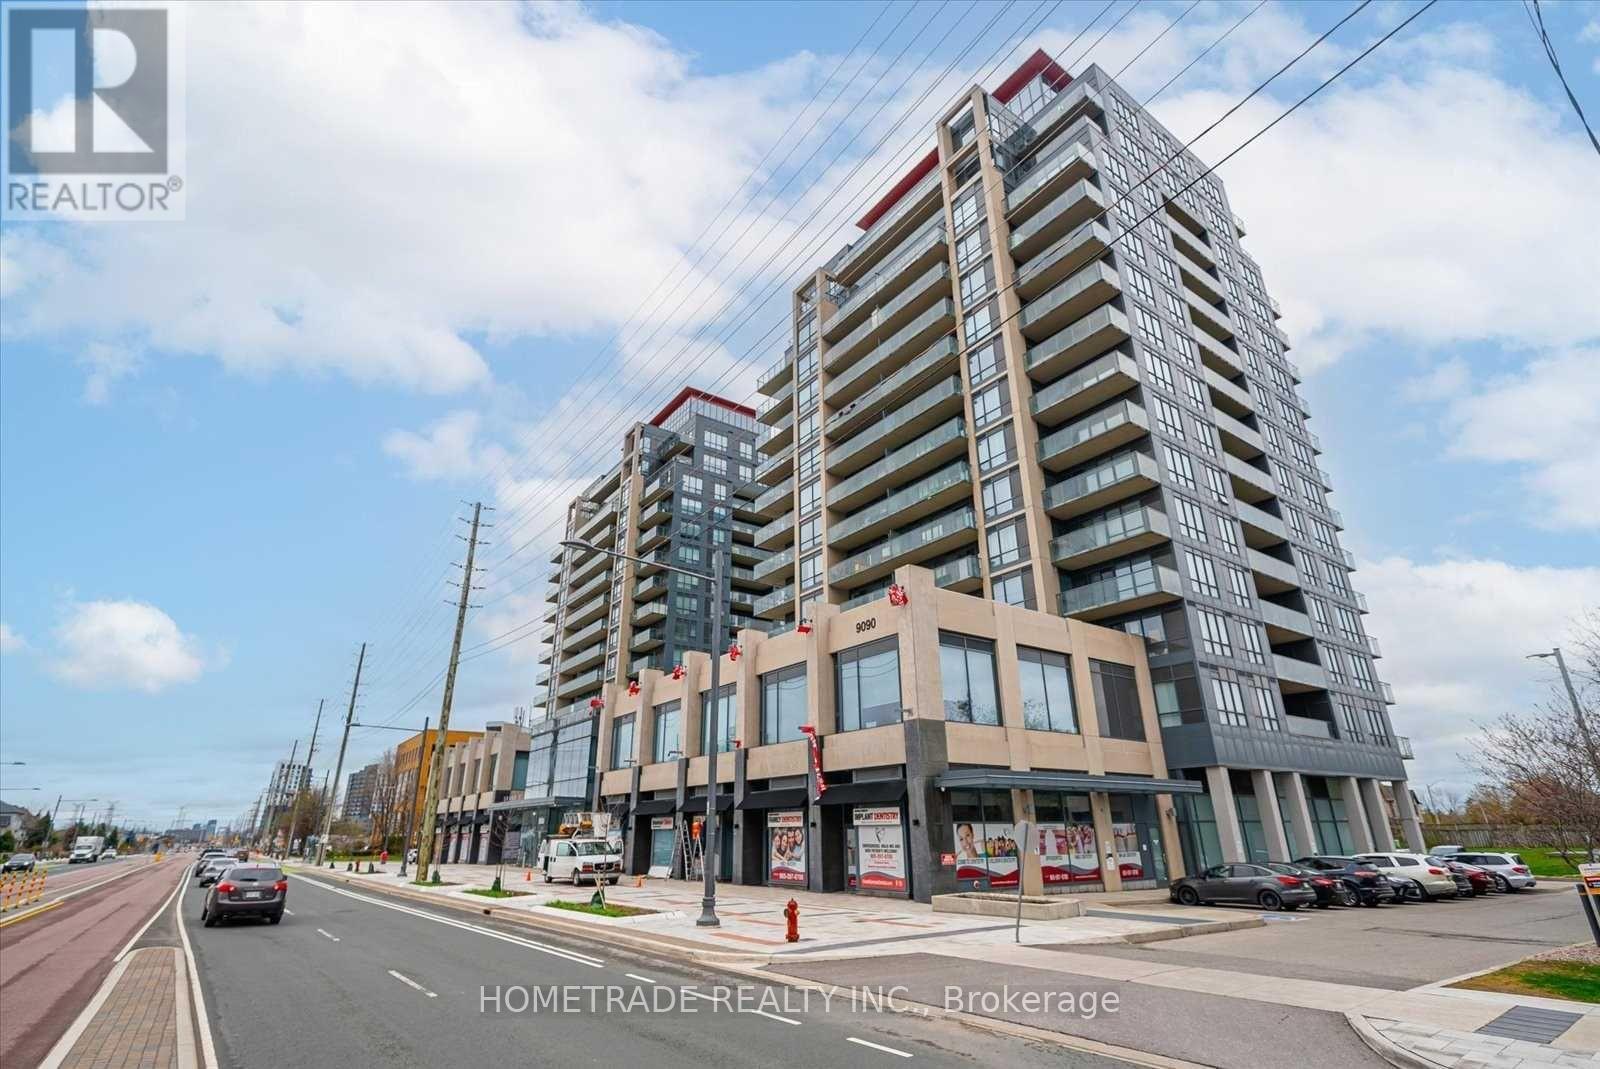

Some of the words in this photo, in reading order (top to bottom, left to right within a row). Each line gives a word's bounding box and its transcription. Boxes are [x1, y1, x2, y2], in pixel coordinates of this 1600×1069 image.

[855, 617, 877, 633] 9090
[854, 812, 873, 821] IMPLANT
[873, 811, 899, 821] DENTISTRY
